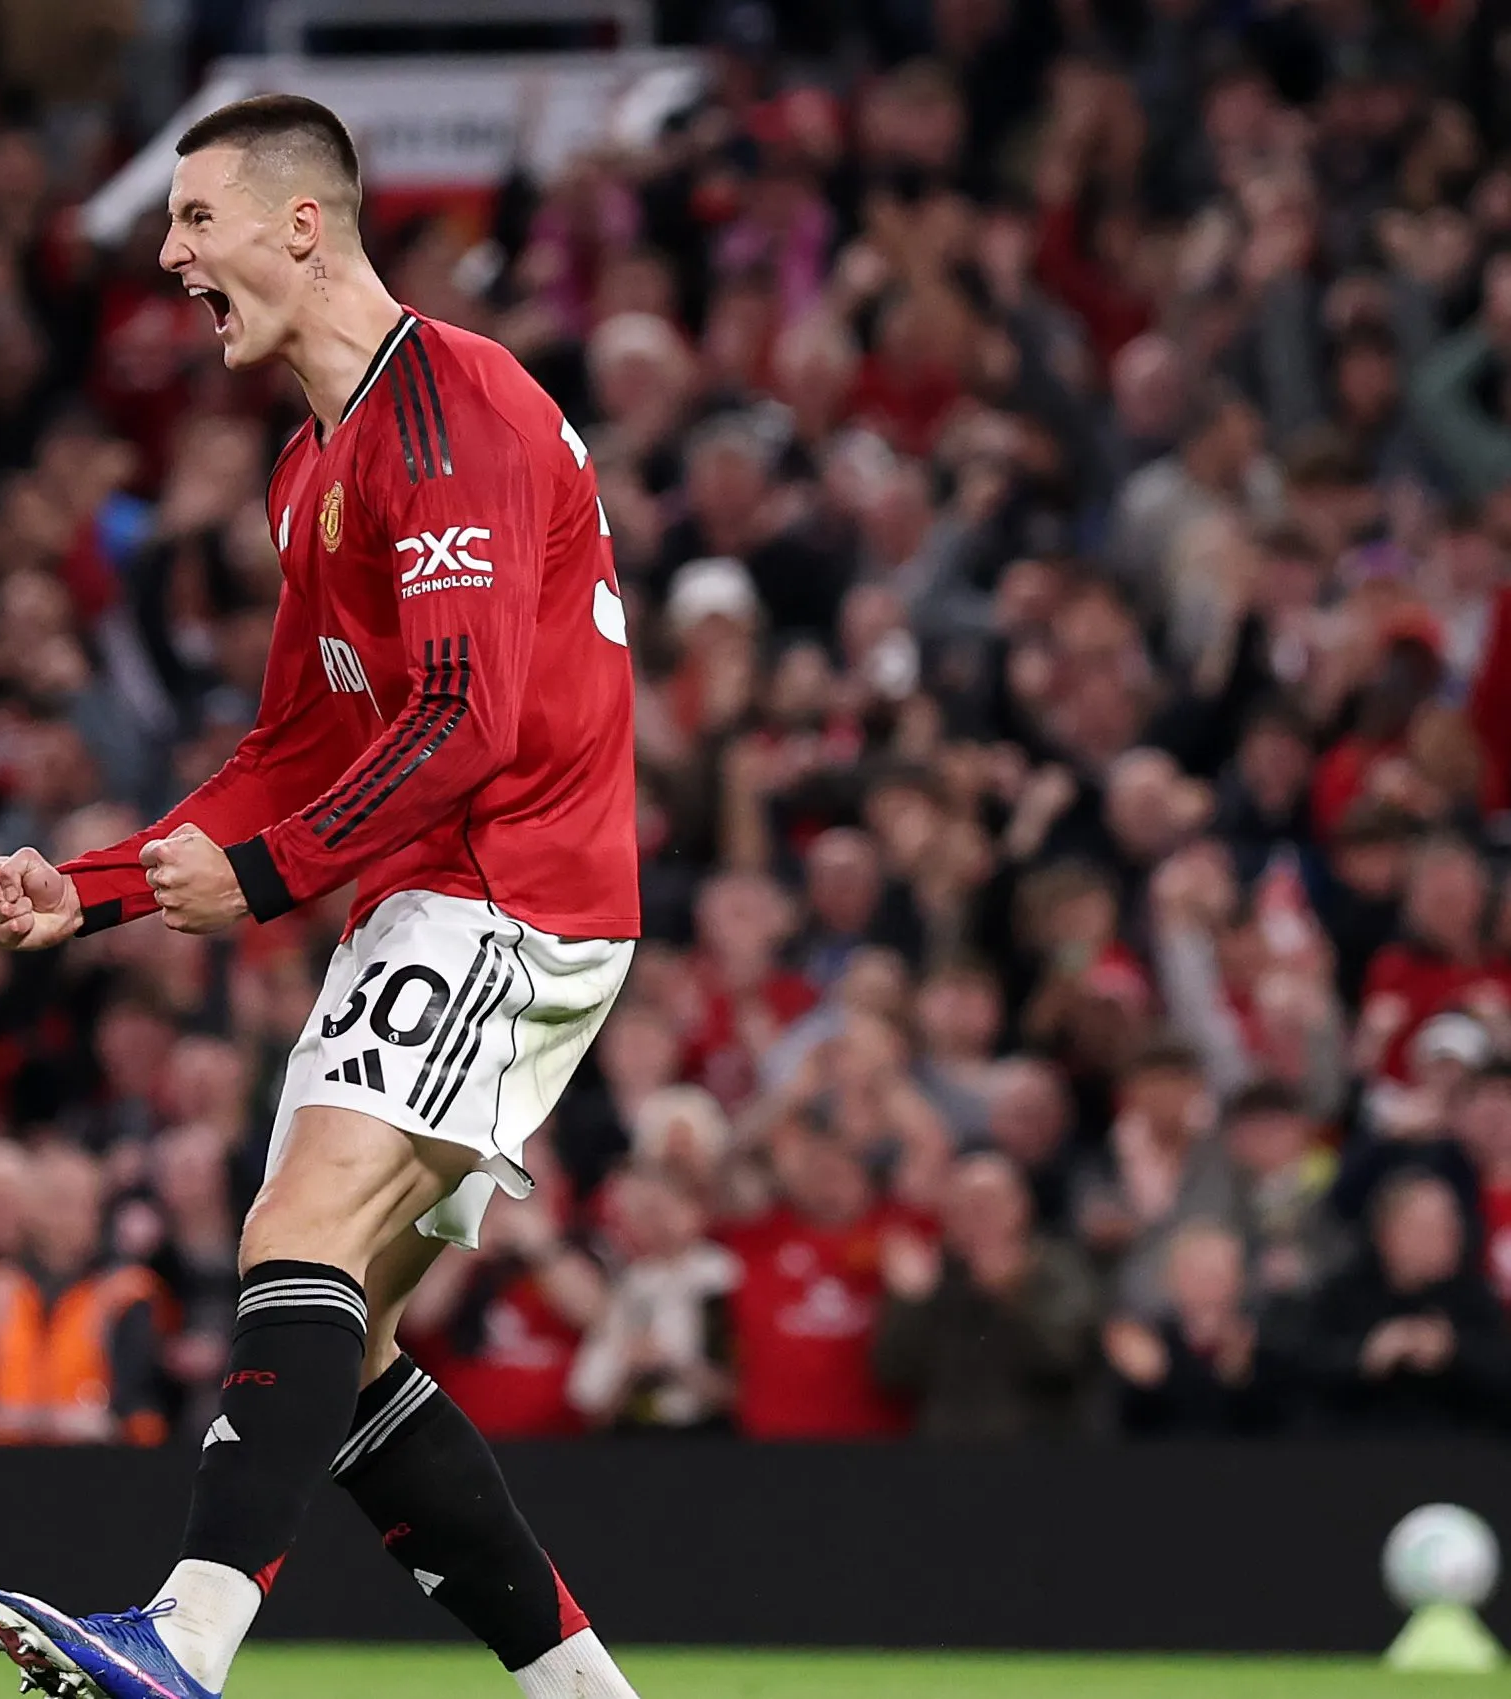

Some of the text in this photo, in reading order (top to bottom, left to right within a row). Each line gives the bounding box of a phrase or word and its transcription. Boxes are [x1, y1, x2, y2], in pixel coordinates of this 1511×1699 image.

[395, 526, 494, 584] DXC
[401, 575, 494, 600] TECHNOLOGY
[320, 961, 451, 1047] 30
